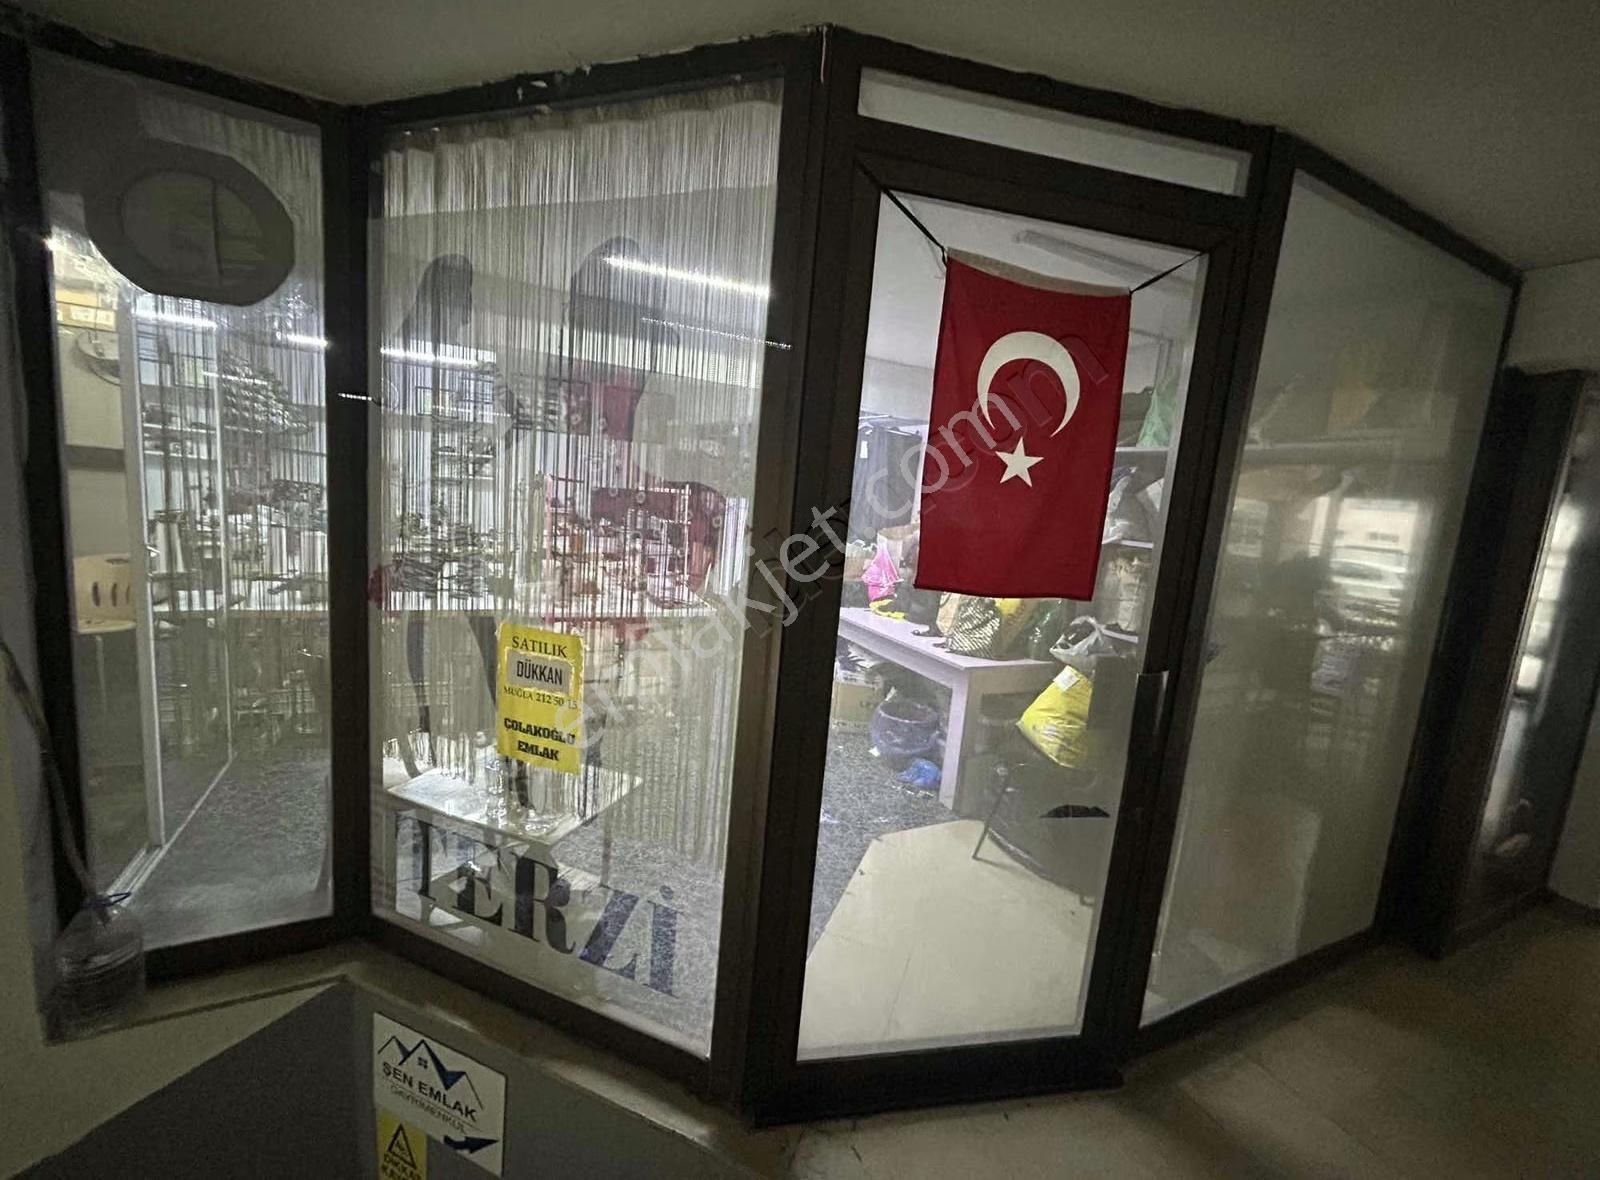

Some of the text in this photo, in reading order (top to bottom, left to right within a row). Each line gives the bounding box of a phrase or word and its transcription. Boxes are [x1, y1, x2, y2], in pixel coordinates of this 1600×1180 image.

[511, 636, 568, 658] SATILIK
[516, 659, 563, 685] DÜKKAN
[517, 740, 559, 761] EMLAK
[395, 811, 687, 999] TERZİ
[418, 1081, 477, 1123] EMLAK
